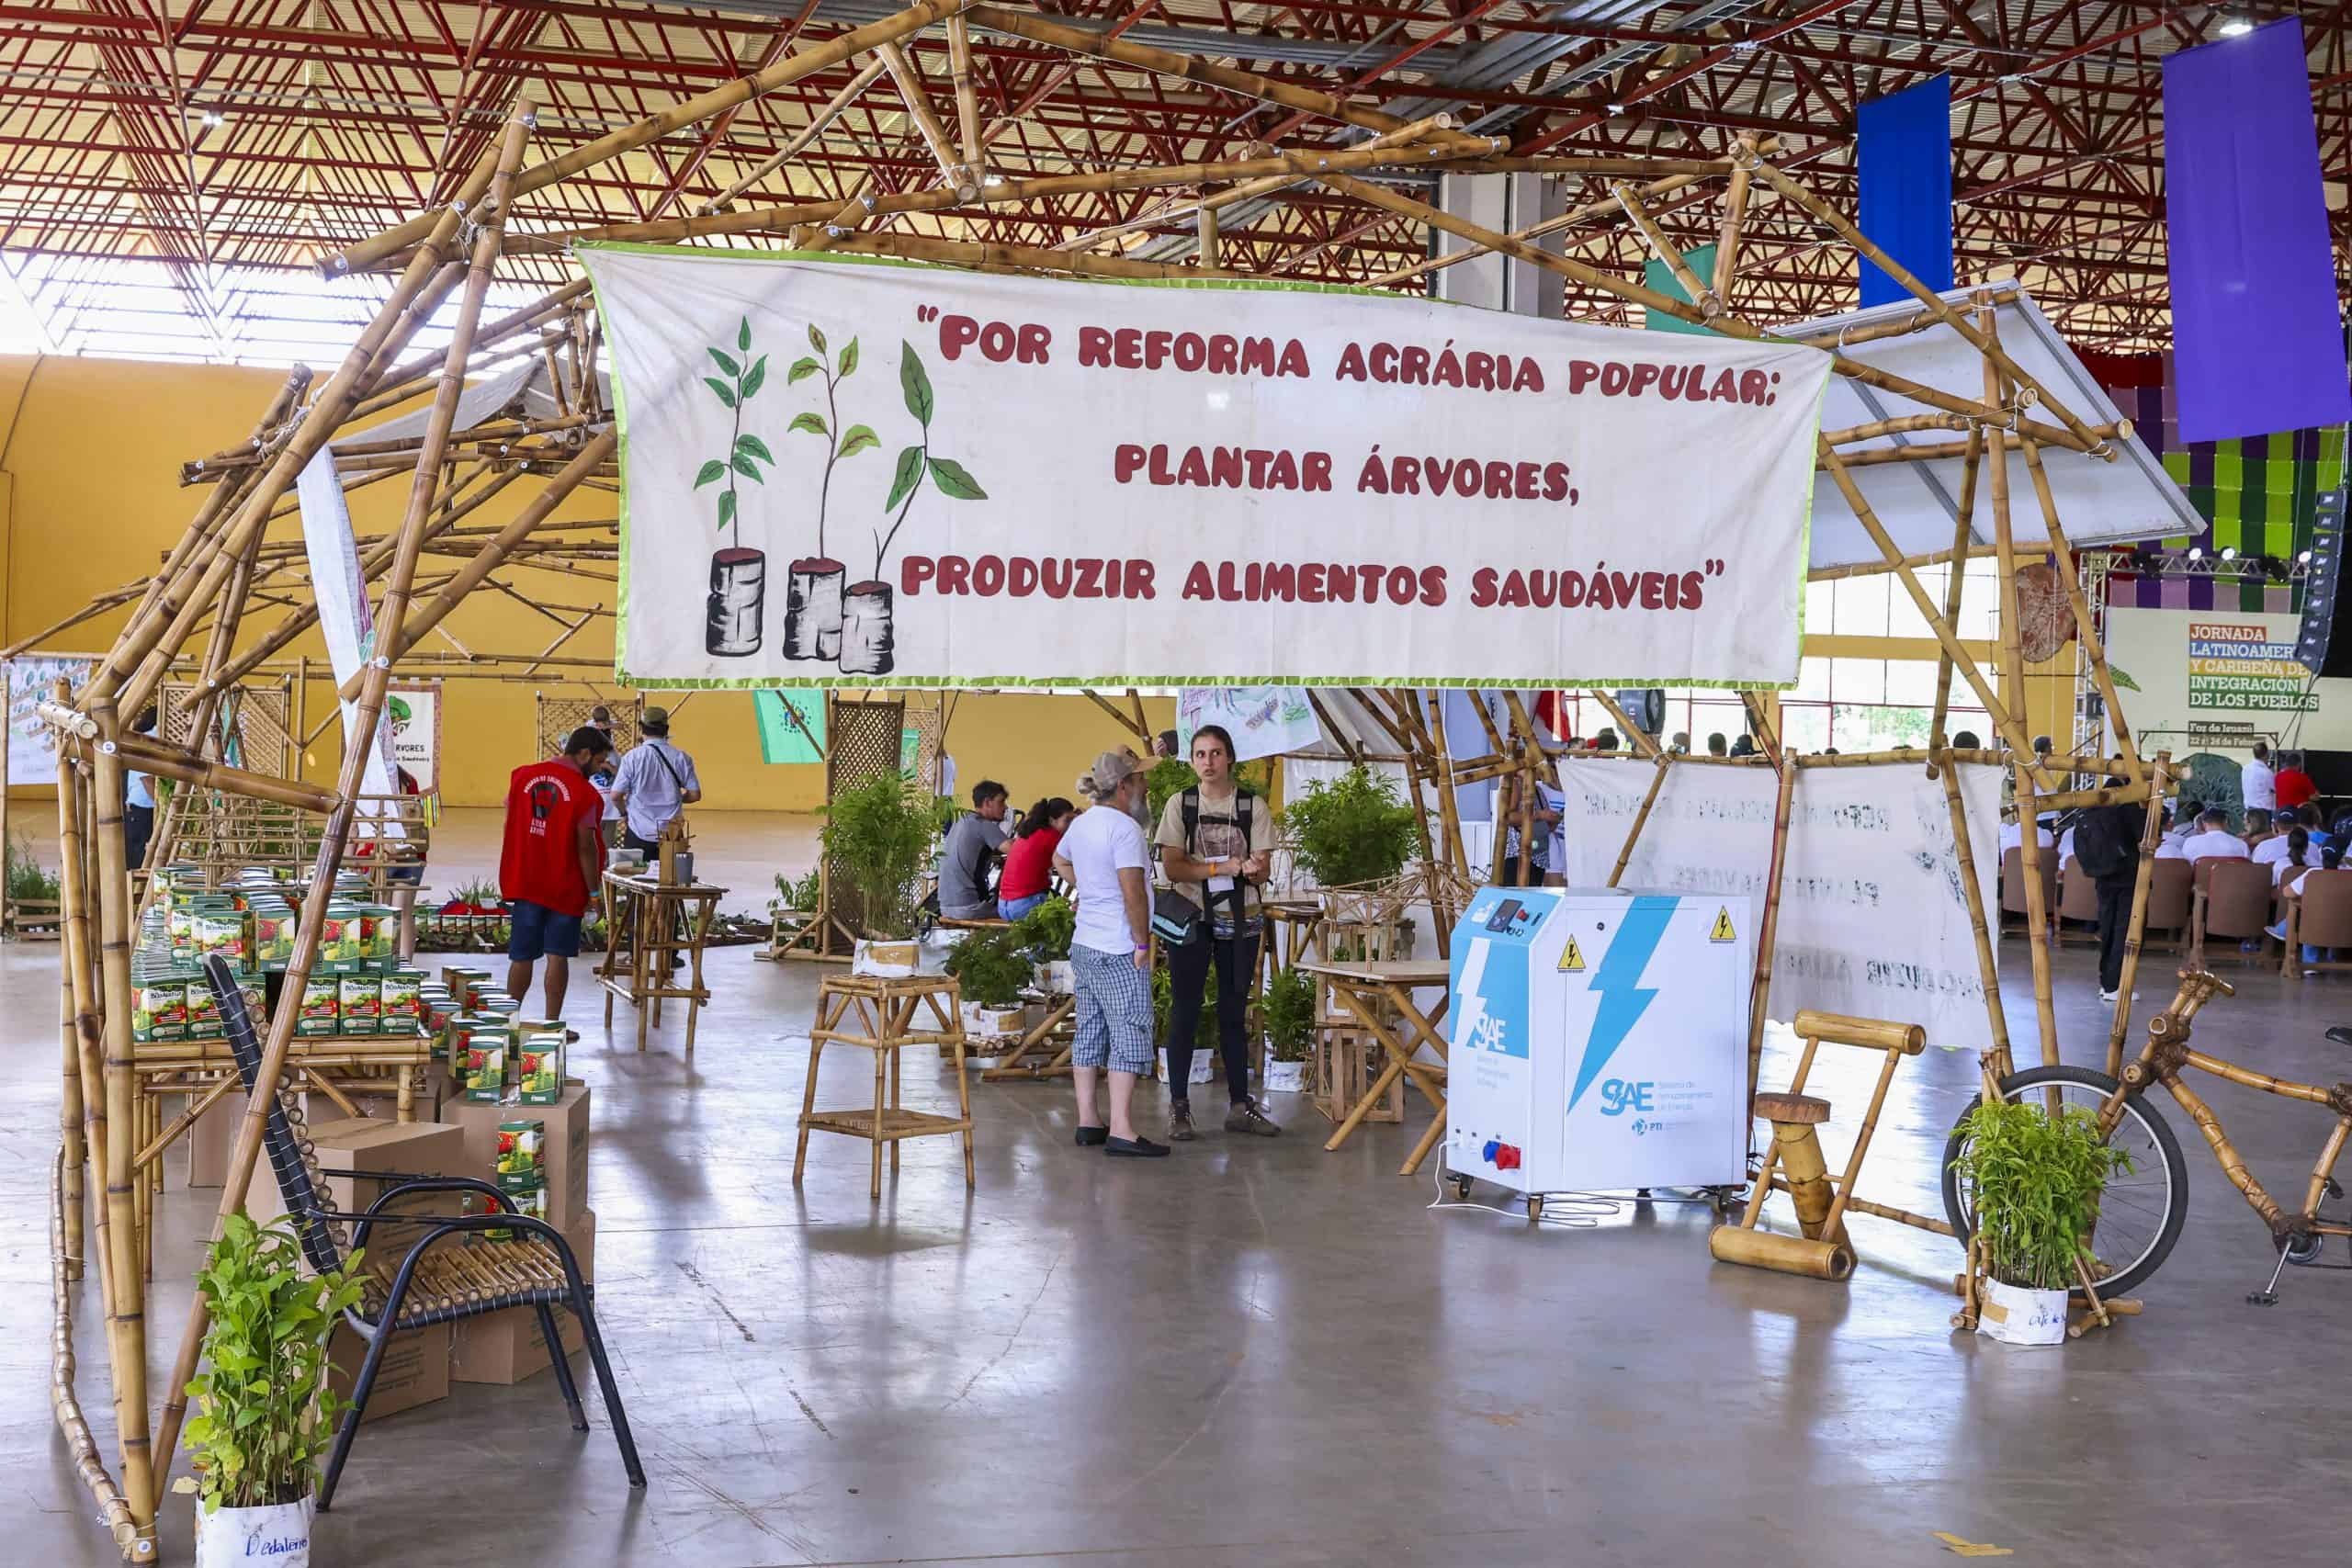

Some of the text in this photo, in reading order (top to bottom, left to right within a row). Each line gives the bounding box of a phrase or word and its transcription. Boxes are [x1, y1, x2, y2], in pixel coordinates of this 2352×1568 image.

[1078, 326, 1311, 378] REFORMA
[1335, 339, 1545, 393] AGRÁRIA
[1114, 443, 1580, 507] PLANTAR ÁRVORES,
[900, 555, 1725, 611] PRODUZIR ALIMENTOS SAUDÁVEIS"
[2190, 626, 2265, 641] JORNADA
[2190, 642, 2294, 660] LATINOAMER
[2190, 660, 2202, 671] Y
[2204, 658, 2283, 675] CARIBEÑA
[2190, 675, 2299, 692] INTEGRACIÓN
[2190, 693, 2318, 709] DE LOS PUEBLOS
[2189, 722, 2207, 733] Foz
[2208, 723, 2222, 733] de
[1600, 1077, 1655, 1117] SAE
